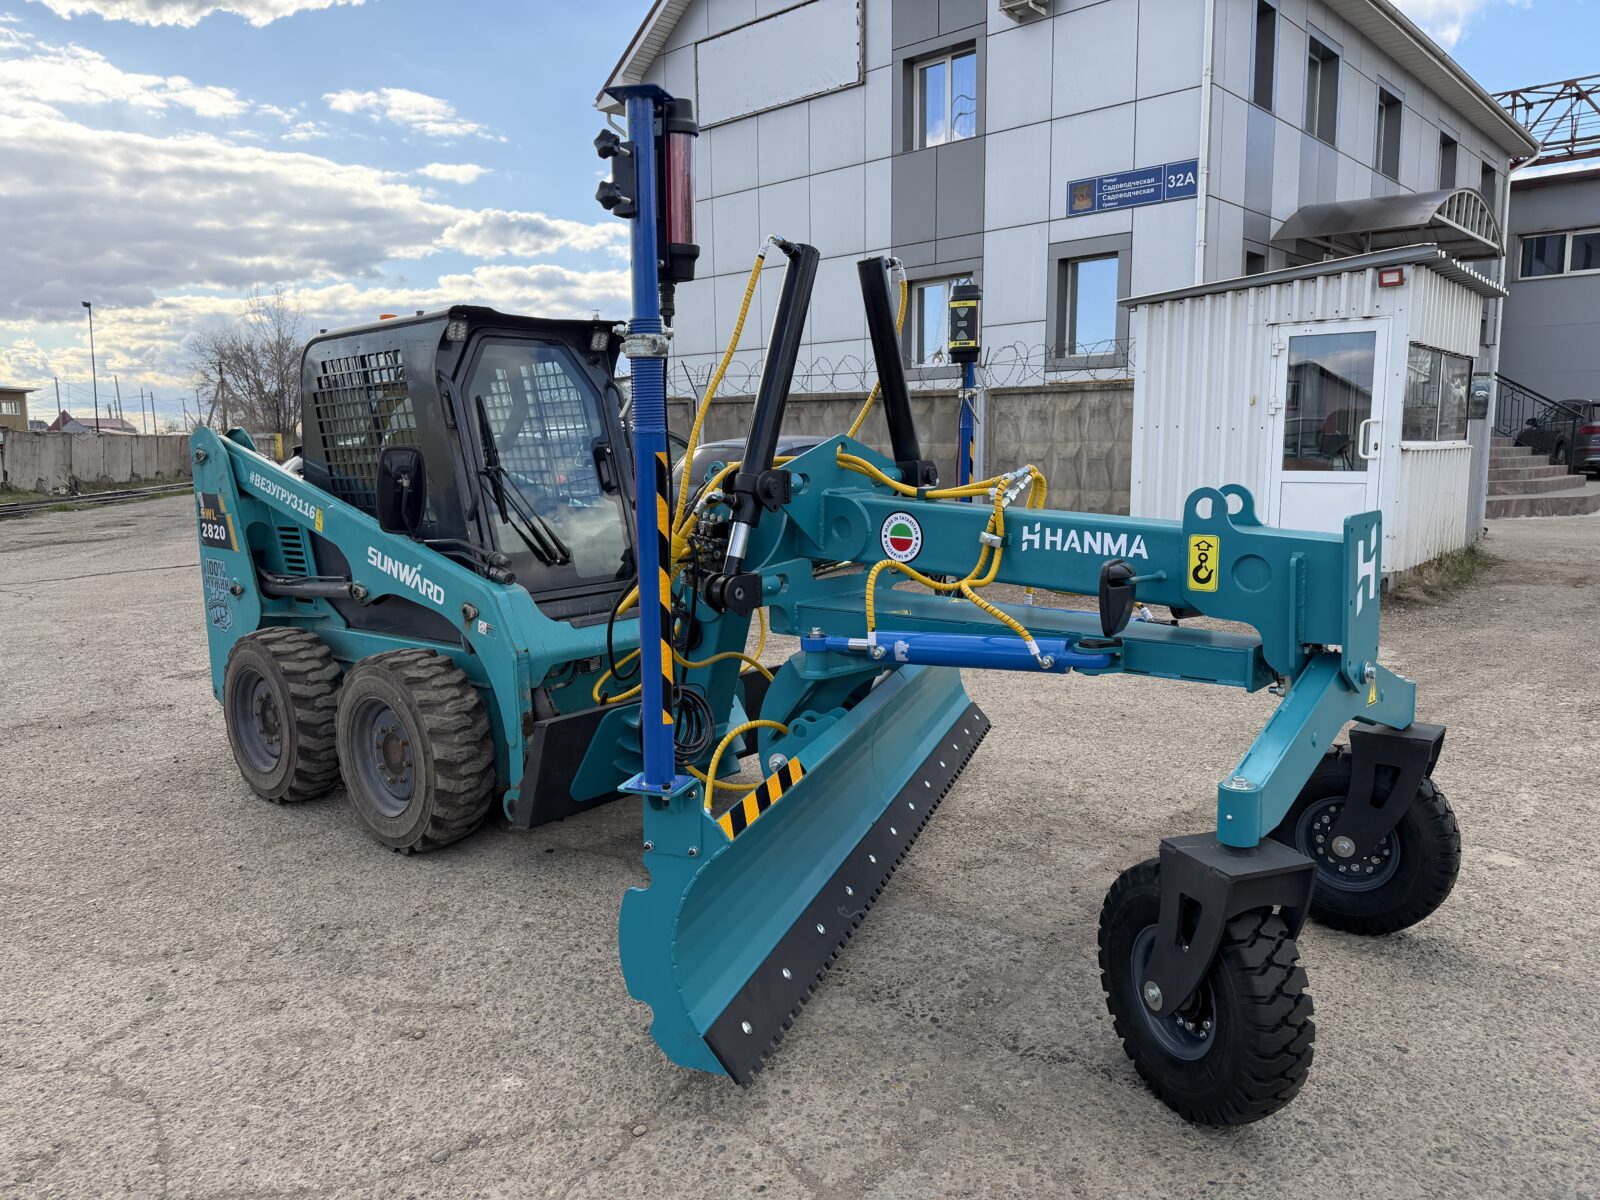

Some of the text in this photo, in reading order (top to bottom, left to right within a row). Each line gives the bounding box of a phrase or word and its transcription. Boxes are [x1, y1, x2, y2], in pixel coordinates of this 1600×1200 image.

[1102, 177, 1155, 191] Садоводческая
[1102, 187, 1155, 201] Садоводческая
[201, 522, 226, 540] 2820
[1044, 527, 1149, 559] HANMA
[206, 560, 226, 577] 100%
[367, 545, 445, 605] SUNWARD
[205, 576, 230, 591] МУЖИК
